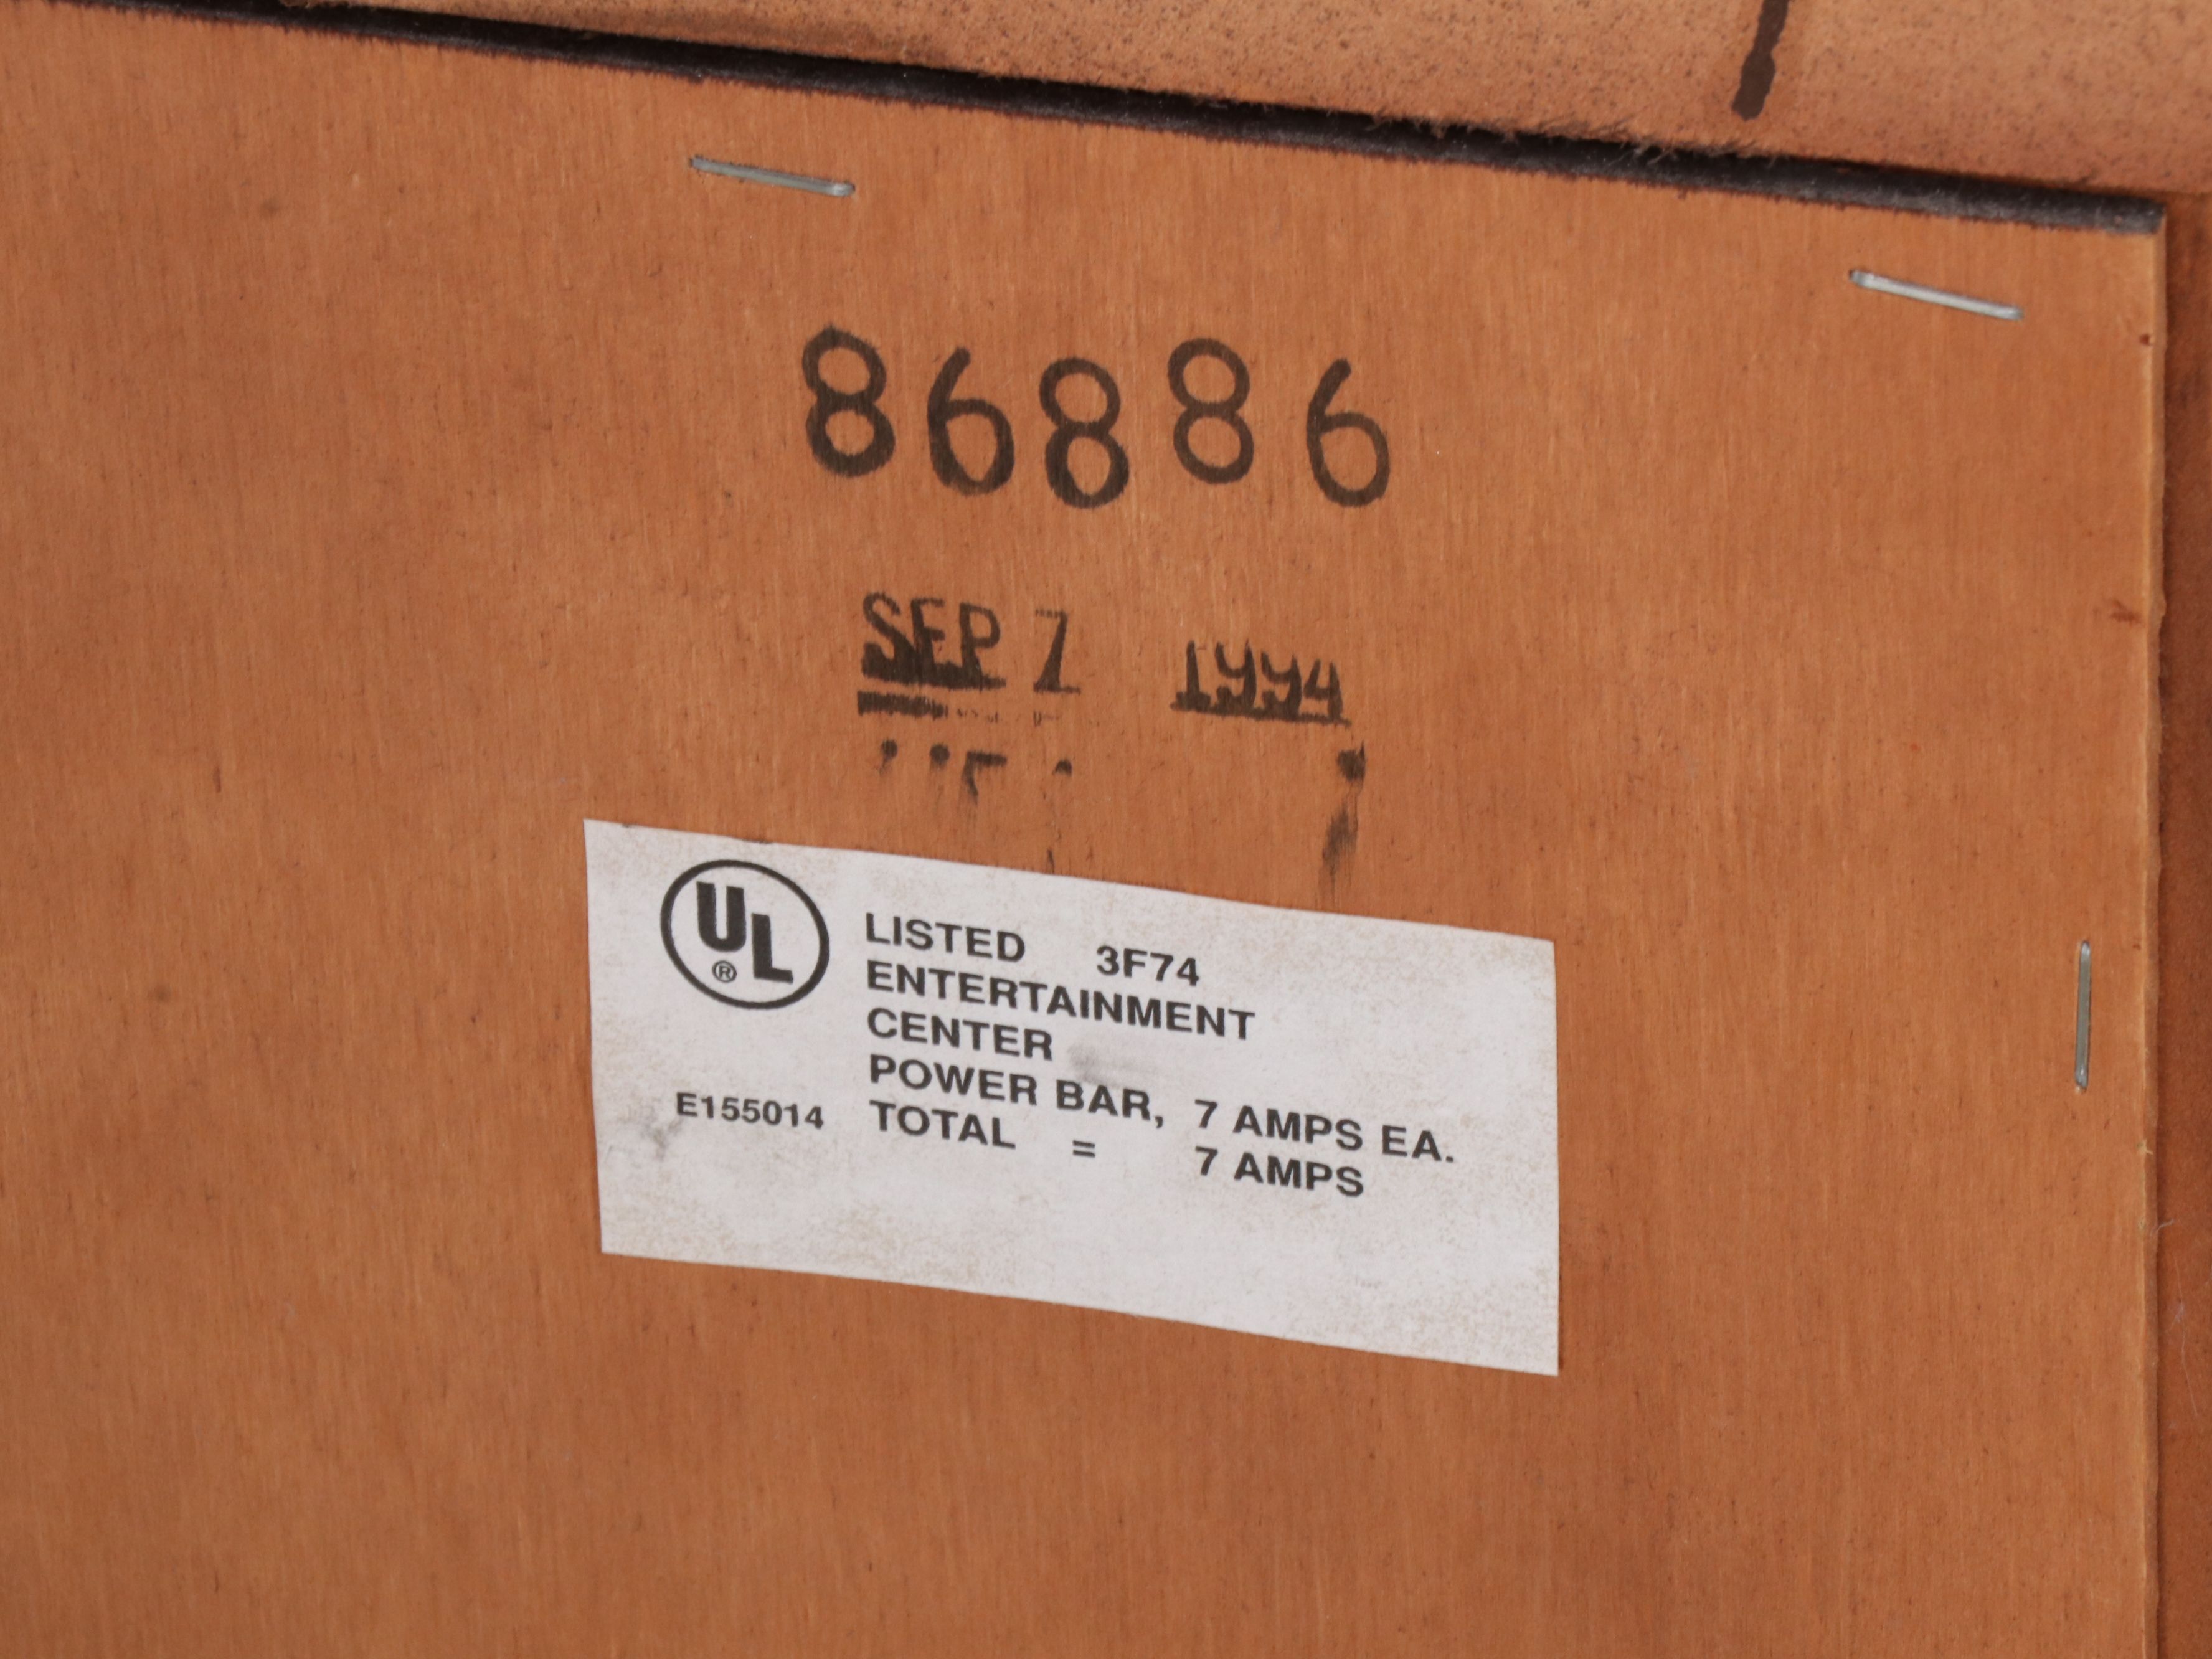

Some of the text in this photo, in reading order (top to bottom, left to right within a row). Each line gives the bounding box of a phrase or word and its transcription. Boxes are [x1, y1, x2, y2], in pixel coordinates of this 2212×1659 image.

[801, 322, 1390, 508] 86886
[861, 593, 1006, 691] SEP
[1170, 639, 1351, 726] 1994
[866, 912, 1200, 986] LISTED 3F74
[867, 960, 1255, 1040] ENTERTAINMENT
[867, 1008, 1052, 1061] CENTER
[676, 1092, 824, 1130] E155014
[869, 1100, 1016, 1150] TOTAL
[1195, 1146, 1219, 1176] 7
[1233, 1151, 1364, 1198] AMPS
[870, 1054, 1455, 1163] POWER BAR, 7 AMPS EA.
